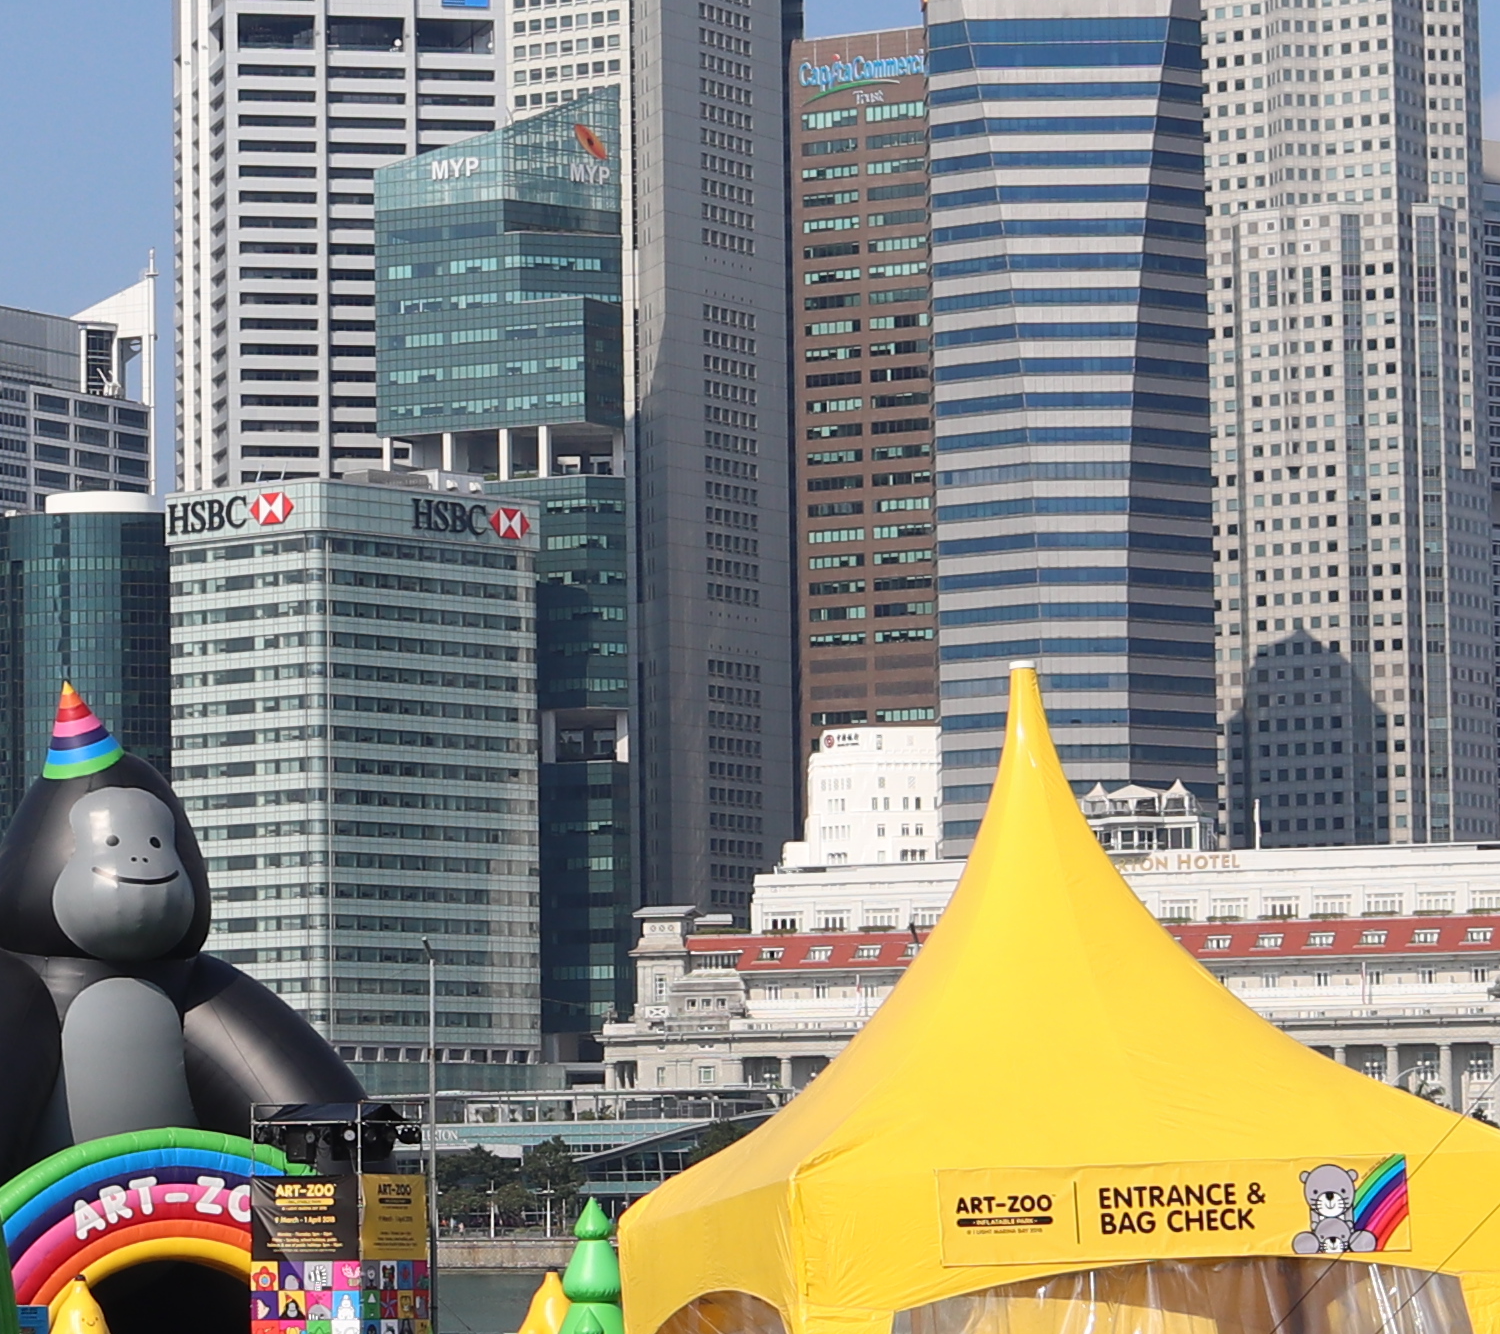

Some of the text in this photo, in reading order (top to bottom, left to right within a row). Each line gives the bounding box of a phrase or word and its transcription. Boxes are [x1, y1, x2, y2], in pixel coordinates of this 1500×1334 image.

[799, 48, 925, 92] CapitaCommerci
[431, 157, 480, 180] MYP
[570, 163, 611, 185] MYP
[167, 496, 248, 536] HSBC
[413, 497, 487, 537] HSBC
[1116, 853, 1241, 872] RTON HOTEL
[275, 1184, 336, 1197] ART-ZOO
[1099, 1181, 1266, 1210] ENTRANCE &
[73, 1175, 251, 1241] ART-ZO
[955, 1194, 1053, 1215] ART-ZOO
[1100, 1208, 1256, 1235] BAG CHECK
